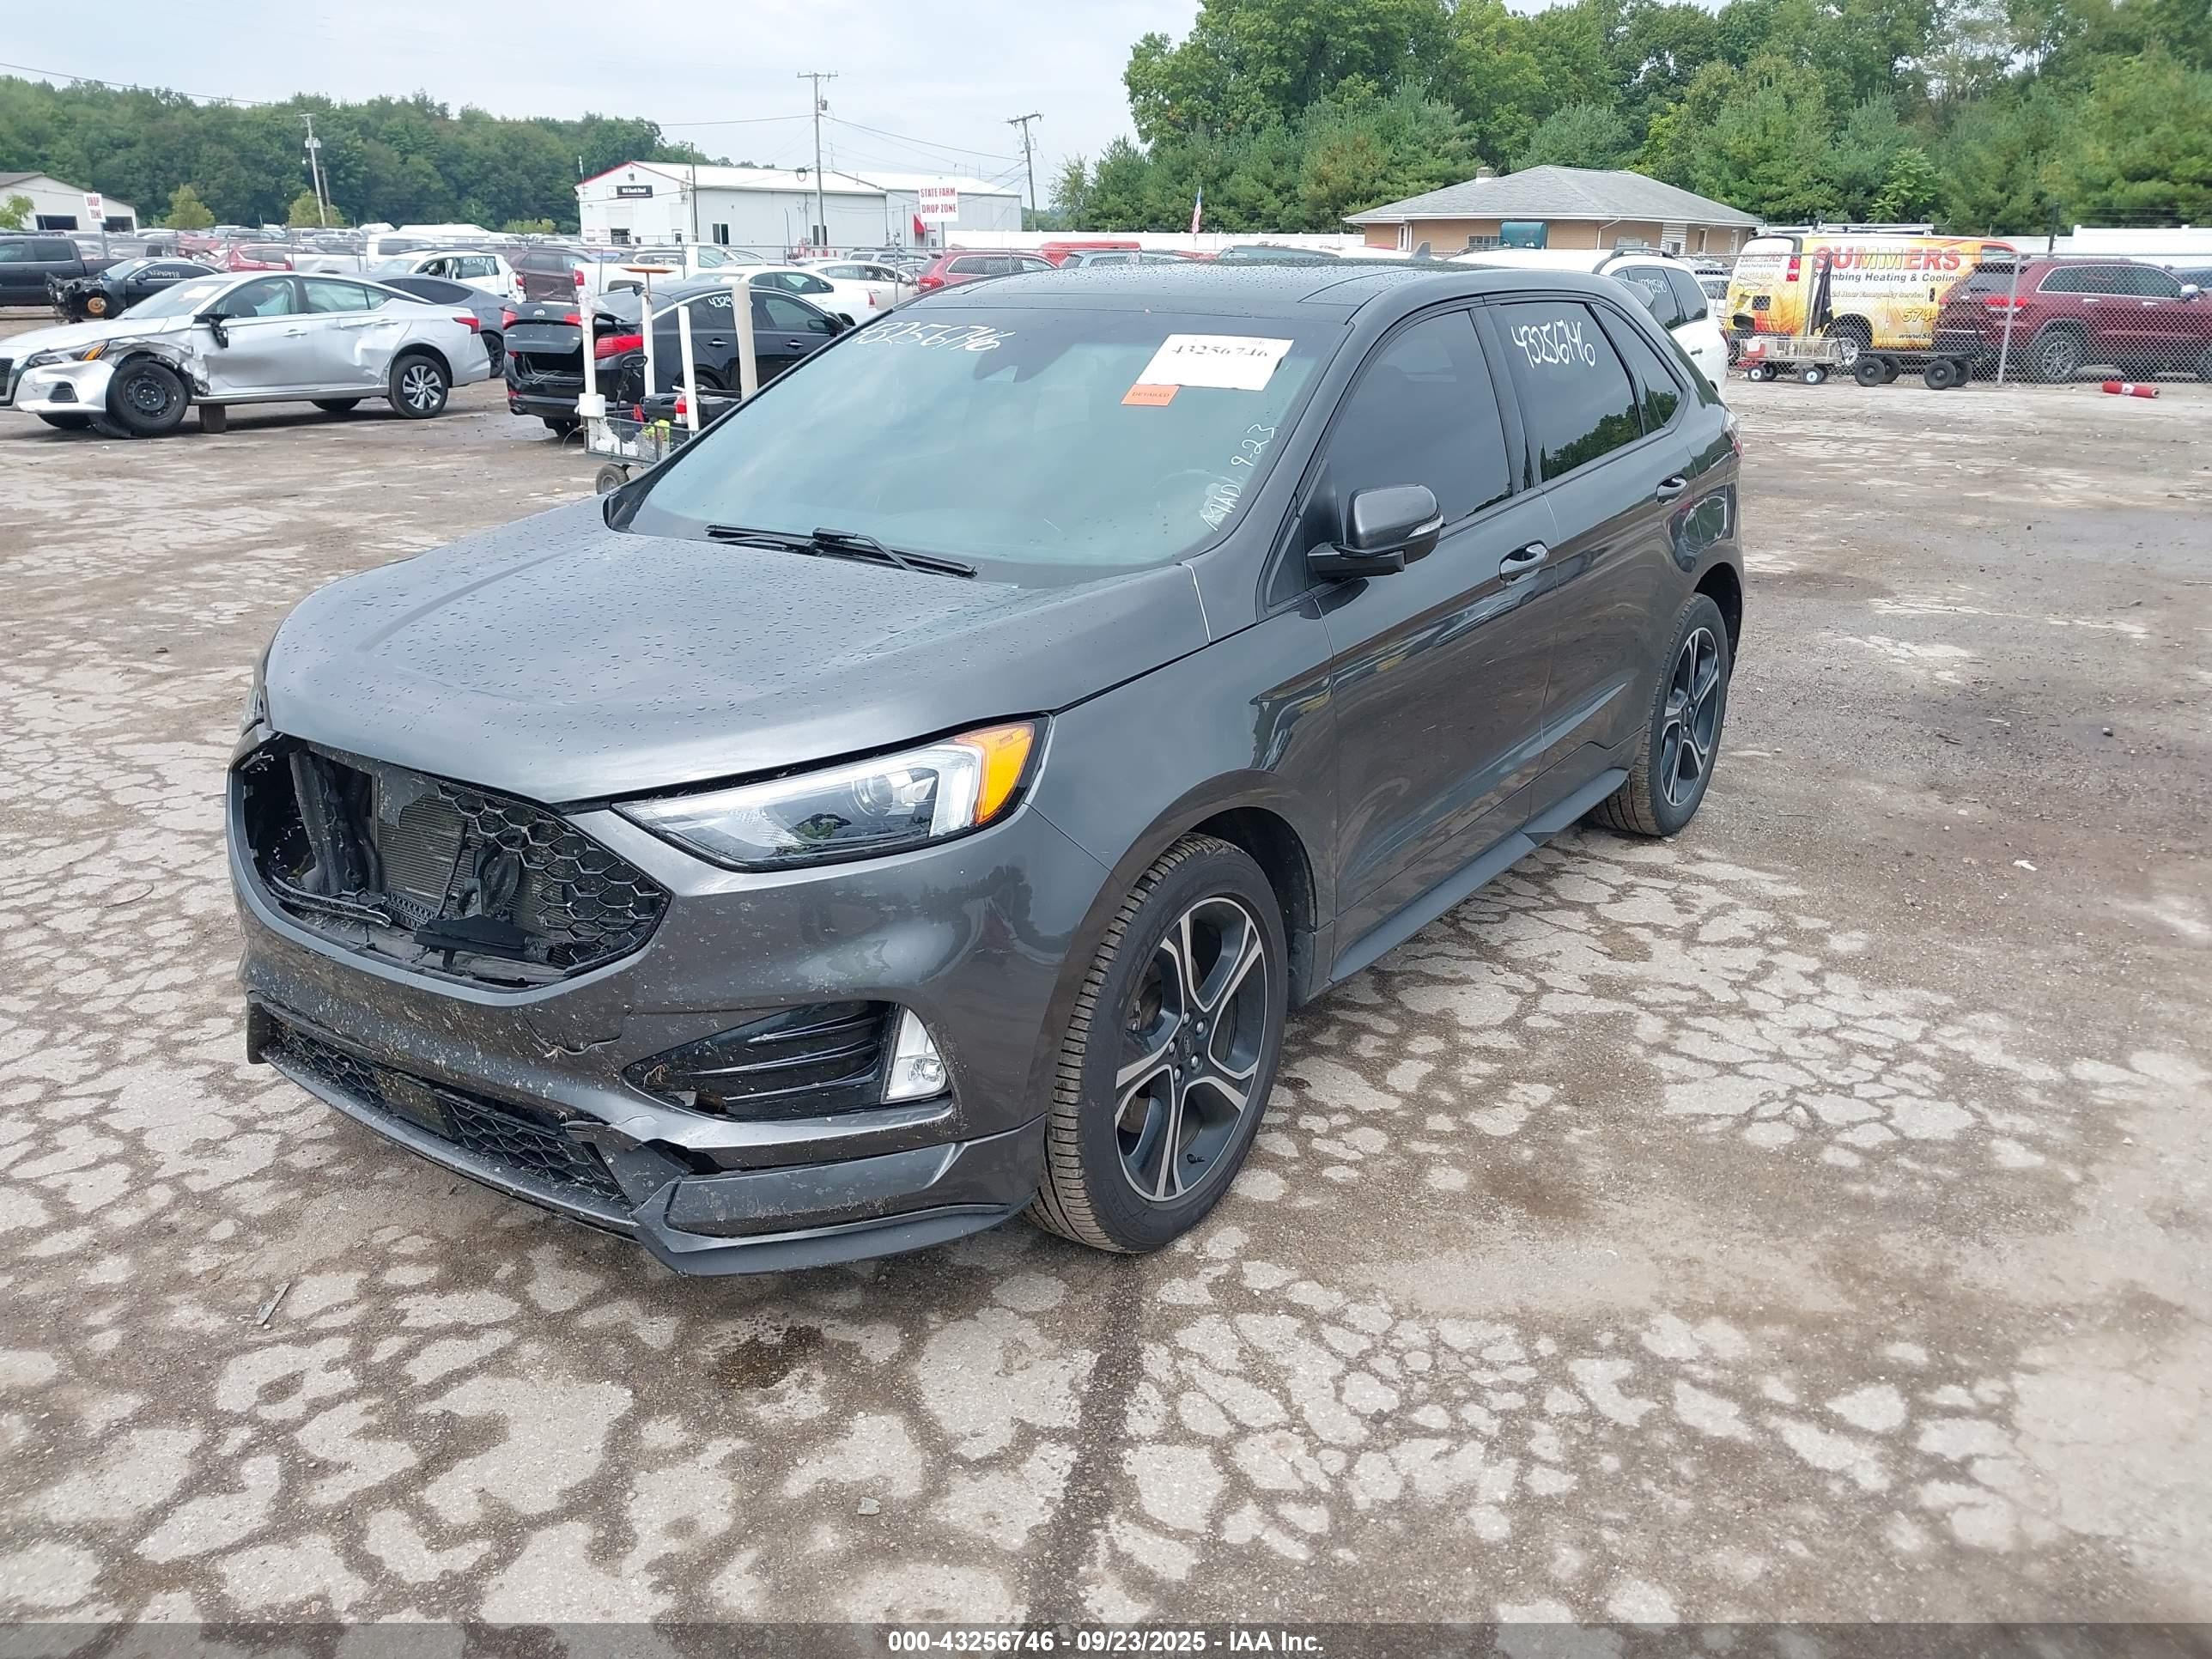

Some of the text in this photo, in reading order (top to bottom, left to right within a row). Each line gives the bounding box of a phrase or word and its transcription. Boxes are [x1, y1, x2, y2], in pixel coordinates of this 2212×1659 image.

[920, 186, 956, 198] STATE FARM
[921, 203, 957, 214] DROP ZONE
[1813, 245, 1961, 270] SUMMERS
[1813, 272, 1862, 283] Plmbing
[1864, 272, 1905, 283] Heating
[1910, 273, 1917, 283] &
[1511, 319, 1596, 368] 43256746
[1171, 344, 1267, 357] 43256746
[1230, 423, 1275, 467] 9-23
